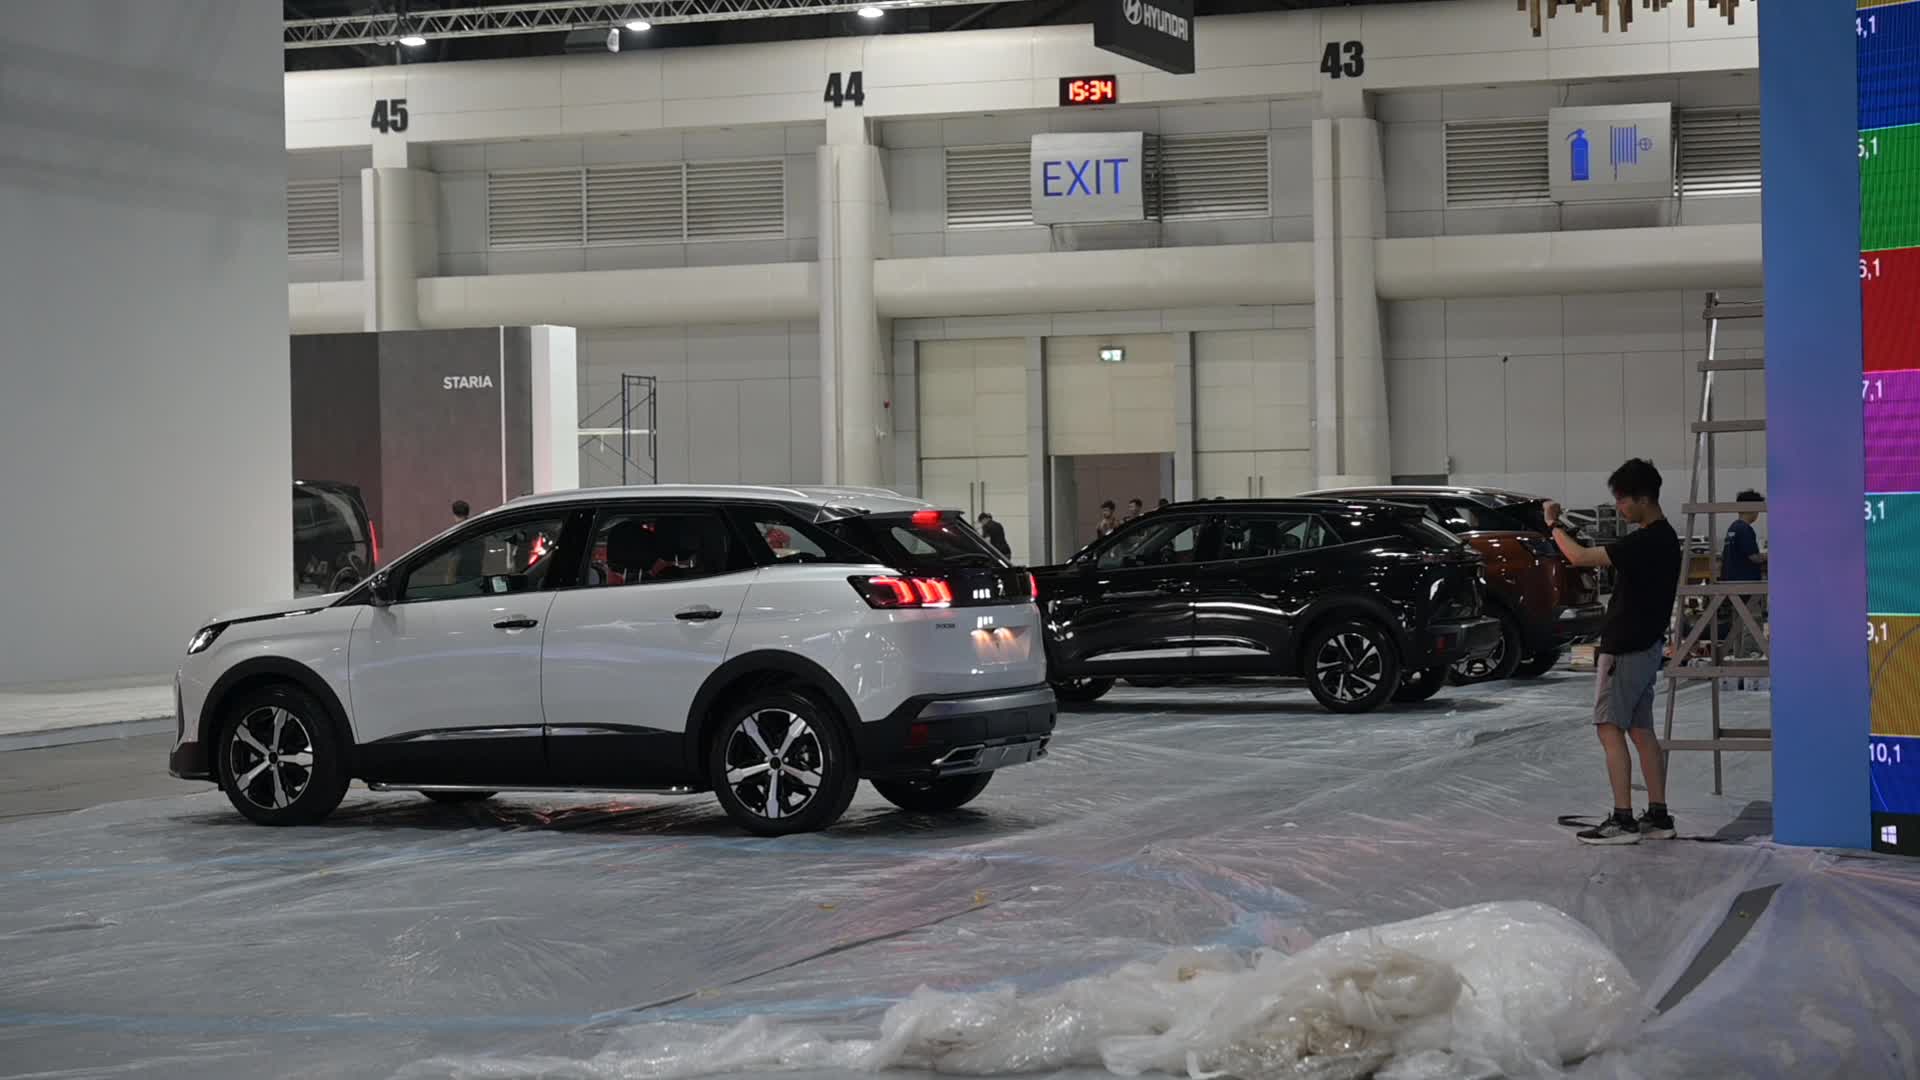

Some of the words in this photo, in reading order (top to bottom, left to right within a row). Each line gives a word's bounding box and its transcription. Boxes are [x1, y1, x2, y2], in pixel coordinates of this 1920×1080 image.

[1143, 3, 1188, 41] HYUNDAI
[1320, 41, 1364, 79] 43
[824, 71, 865, 107] 44
[1068, 79, 1113, 101] 15:34
[371, 99, 408, 133] 45
[1043, 158, 1128, 196] EXIT
[443, 376, 493, 389] STARIA
[1868, 743, 1900, 766] 10,1
